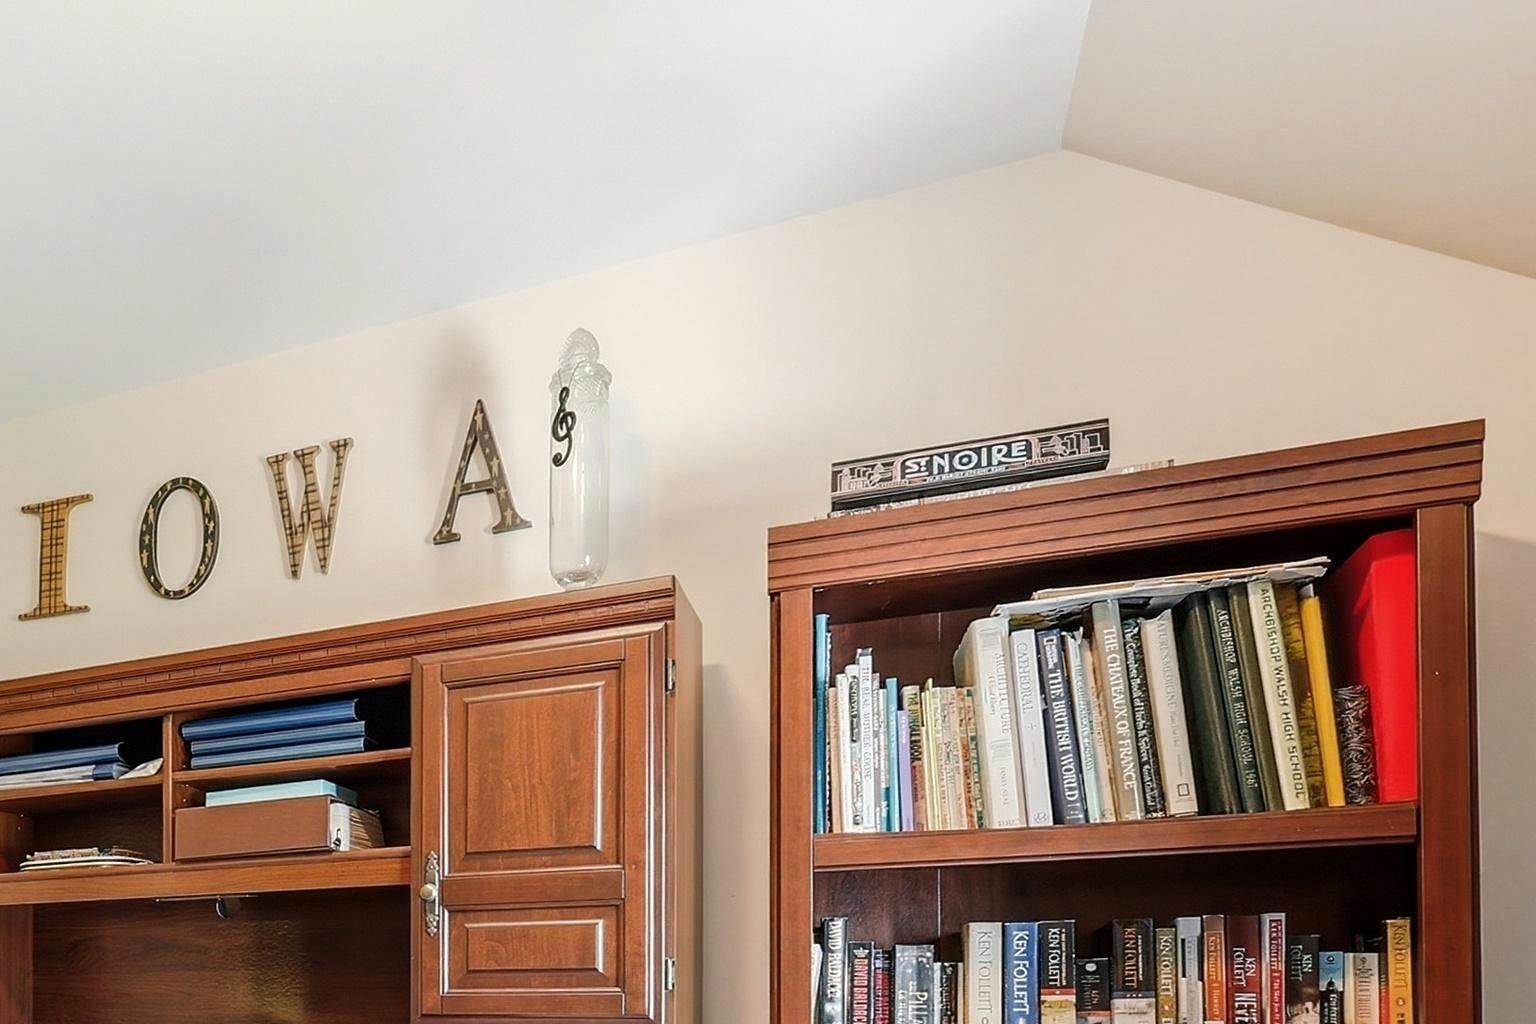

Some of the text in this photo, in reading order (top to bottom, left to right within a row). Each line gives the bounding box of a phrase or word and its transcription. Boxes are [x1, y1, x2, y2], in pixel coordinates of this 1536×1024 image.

[933, 440, 1027, 475] NOIRE
[18, 398, 533, 622] IOWA
[1102, 625, 1137, 791] THE CHATEAUX OF FRANCE
[1233, 702, 1248, 725] HIGH
[1261, 588, 1305, 799] ARCHBISHOP WALSH HIGH SCHOOL
[1047, 669, 1078, 801] THE BRITISH WORLD
[827, 919, 842, 950] DAVID
[976, 930, 993, 958] KEN
[1048, 928, 1062, 988] KEN FOLLETT
[1124, 927, 1138, 989] KEN FOLLETT
[1393, 924, 1408, 946] KEN
[853, 958, 868, 986] DAVID
[976, 960, 993, 1014] FOLLETT
[1012, 930, 1030, 1015] KEN FOLLETT
[1160, 934, 1174, 997] KEN FOLLETT
[1232, 947, 1247, 988] FOLLETT
[1246, 957, 1257, 977] KEN
